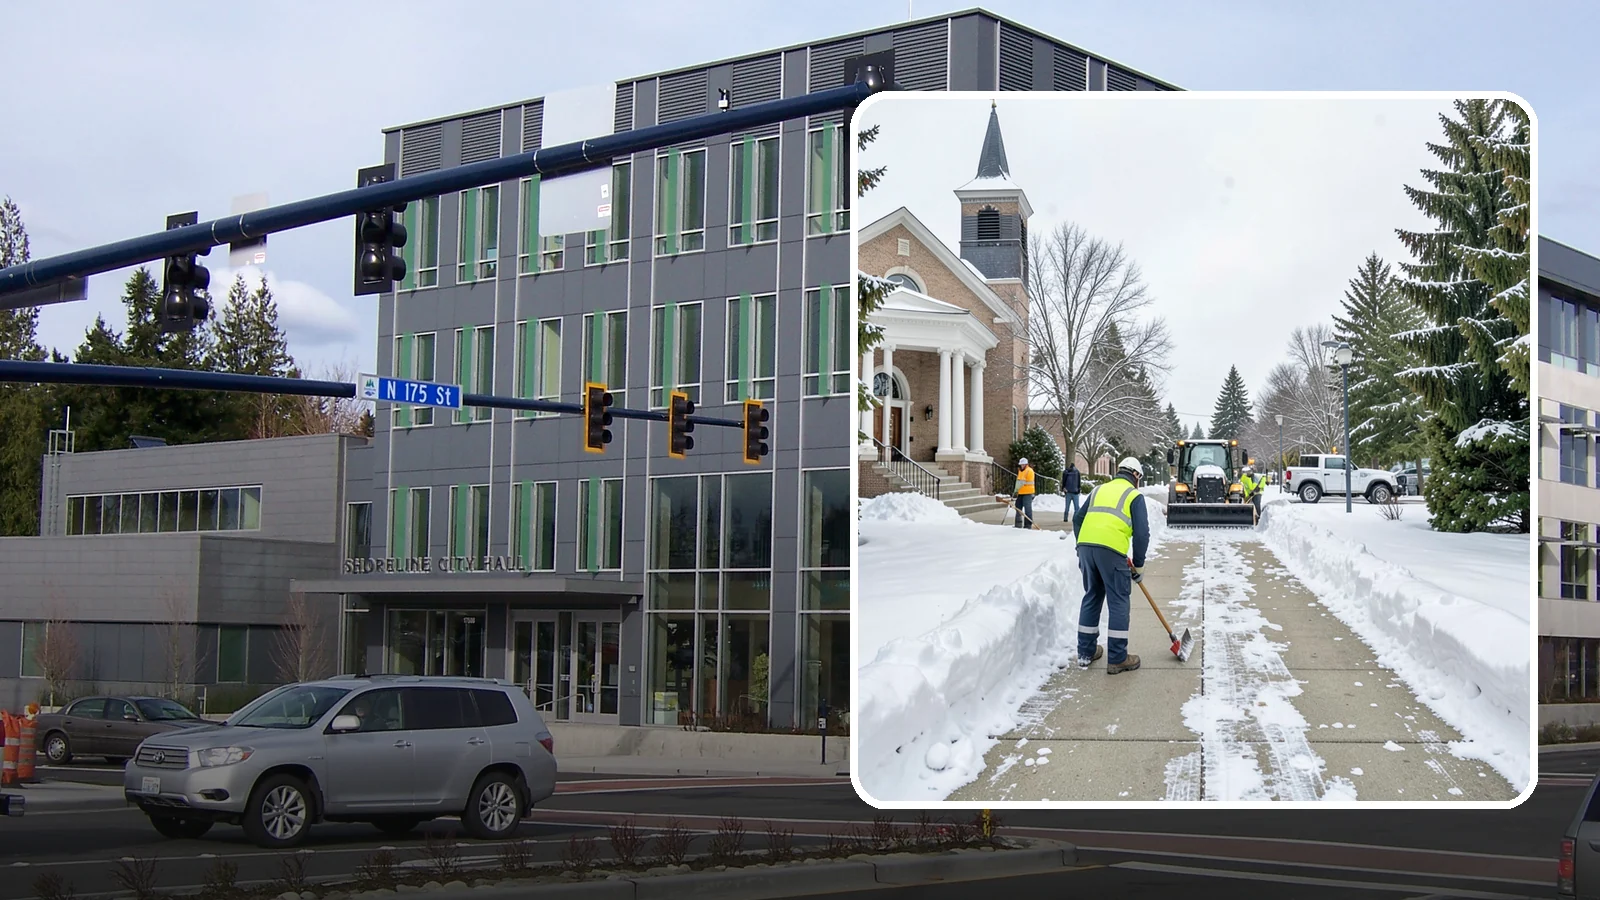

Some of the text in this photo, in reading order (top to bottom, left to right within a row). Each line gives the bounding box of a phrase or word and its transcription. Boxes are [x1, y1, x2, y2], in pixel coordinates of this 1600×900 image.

[387, 380, 451, 406] N 175 St
[344, 555, 526, 574] SHORELINE CITY HALL
